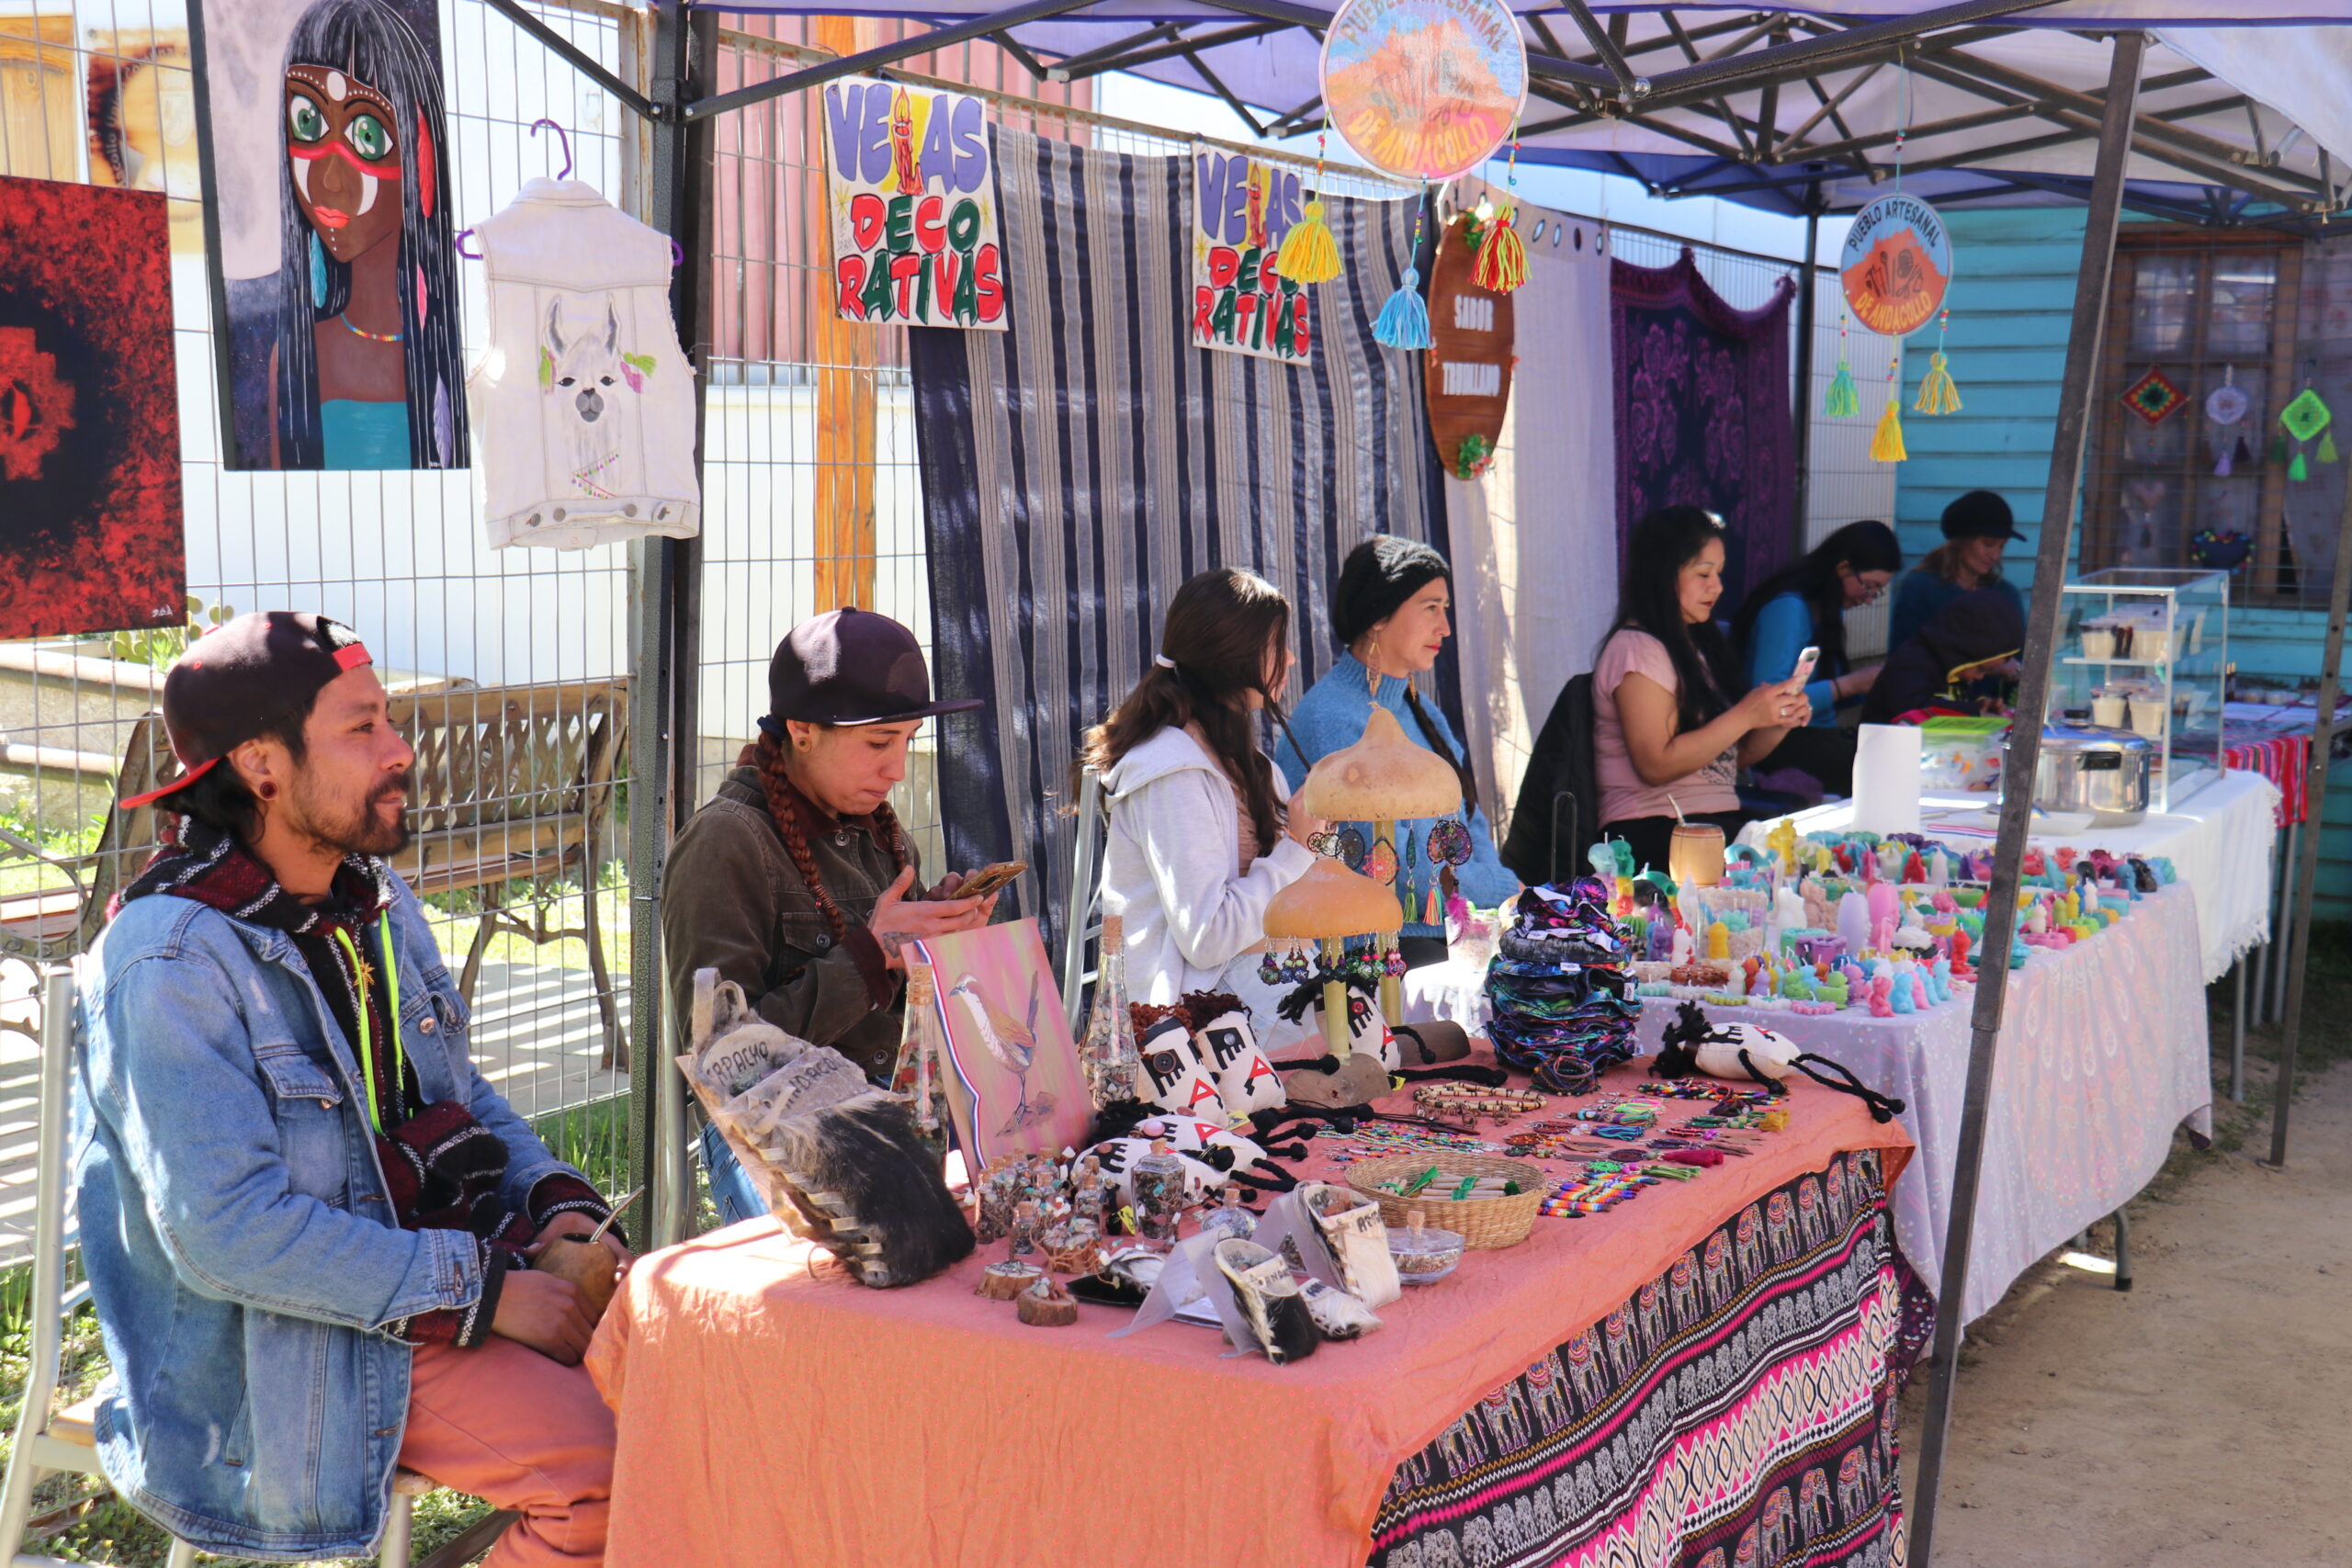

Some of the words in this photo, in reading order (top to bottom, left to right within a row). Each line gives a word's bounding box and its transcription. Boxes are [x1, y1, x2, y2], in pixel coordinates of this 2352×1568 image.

[828, 82, 987, 196] VELAS
[1348, 107, 1387, 149] DE
[1373, 117, 1489, 171] ANDACOLLO
[850, 193, 981, 254] DECO
[1196, 152, 1304, 252] VELAS
[1849, 206, 1883, 252] PUEBLO
[1885, 200, 1941, 248] ARTESANAL
[837, 243, 1005, 327] RATIVAS
[1453, 293, 1494, 333] SABOR
[1854, 290, 1874, 317] DE
[1870, 290, 1932, 330] ANDACOLLO
[1193, 286, 1310, 360] RATIVAS
